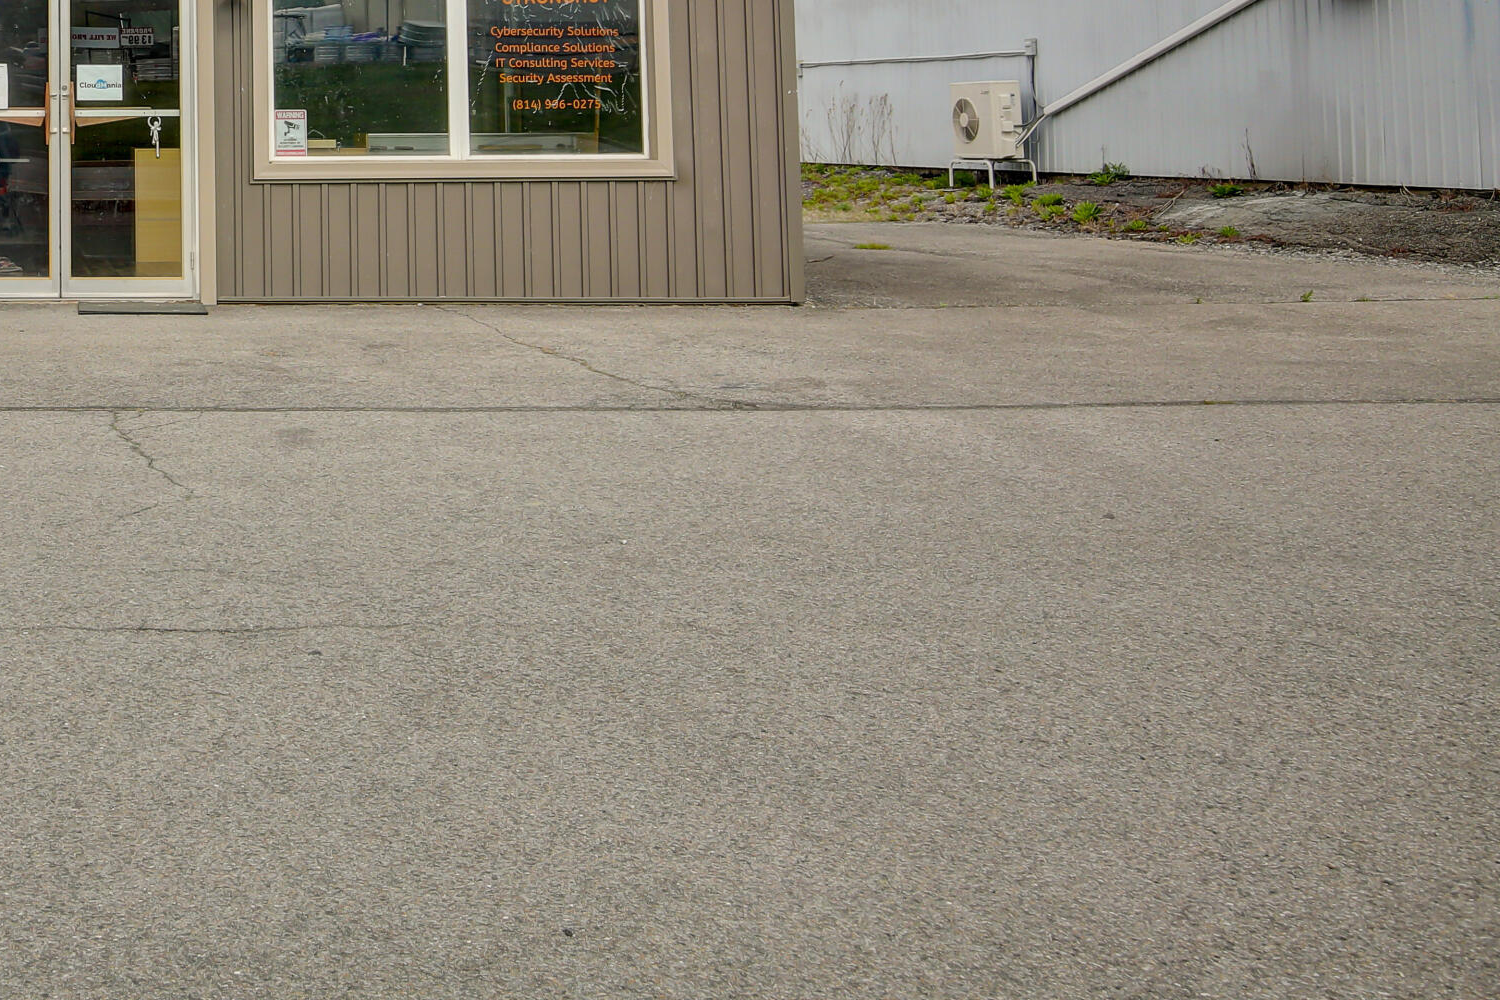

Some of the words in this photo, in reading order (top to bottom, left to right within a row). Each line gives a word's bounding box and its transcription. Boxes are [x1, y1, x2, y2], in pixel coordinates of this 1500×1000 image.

[490, 26, 564, 39] Cybersecurity
[567, 26, 619, 37] Solutions
[495, 43, 560, 54] Compliance
[563, 43, 616, 53] Solutions
[495, 58, 505, 68] IT
[508, 58, 567, 70] Consulting
[570, 58, 616, 68] Services
[499, 73, 543, 85] Security
[547, 73, 612, 83] Assessment
[512, 99, 541, 110] (814)
